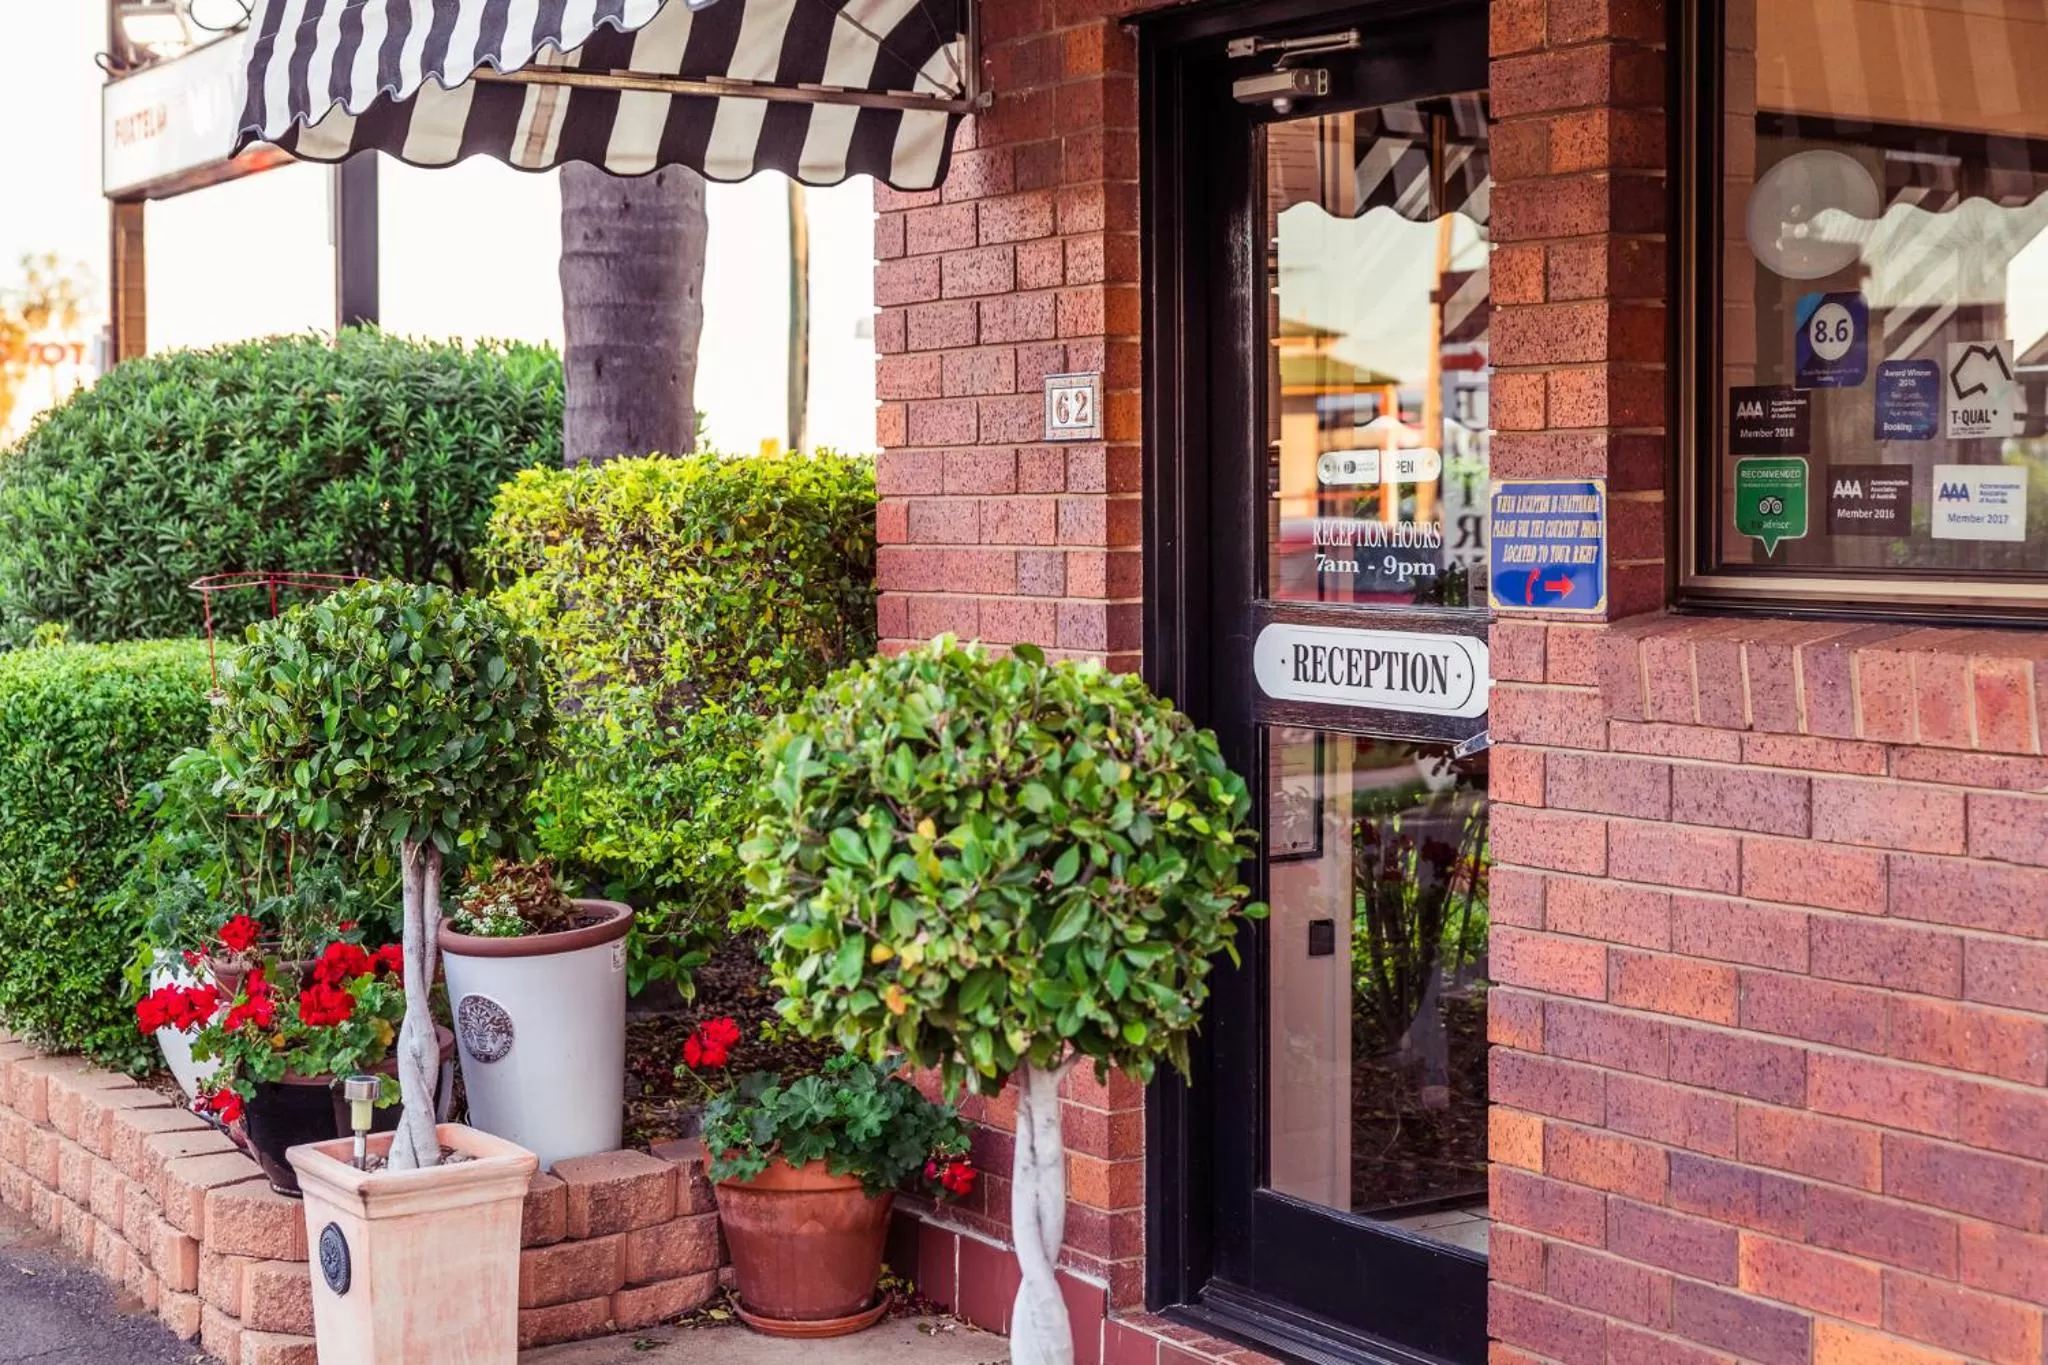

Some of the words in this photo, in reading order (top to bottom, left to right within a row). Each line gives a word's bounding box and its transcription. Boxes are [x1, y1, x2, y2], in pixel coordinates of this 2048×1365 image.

[1815, 318, 1848, 343] 8.6
[1056, 390, 1088, 424] 62
[1736, 401, 1764, 420] AAA
[1740, 429, 1773, 438] Member
[1741, 470, 1801, 479] RECOMMENDED
[1833, 480, 1863, 499] AAA
[1938, 482, 1970, 502] AAA
[1837, 509, 1873, 519] Member
[1874, 508, 1896, 519] 2016
[1948, 513, 1985, 523] Member
[1987, 513, 2009, 524] 2017
[1312, 520, 1389, 549] RECEPTION
[1391, 520, 1441, 549] HOURS
[1314, 553, 1360, 573] 7am
[1383, 555, 1436, 583] 9pm
[1292, 643, 1449, 695] RECEPTION
